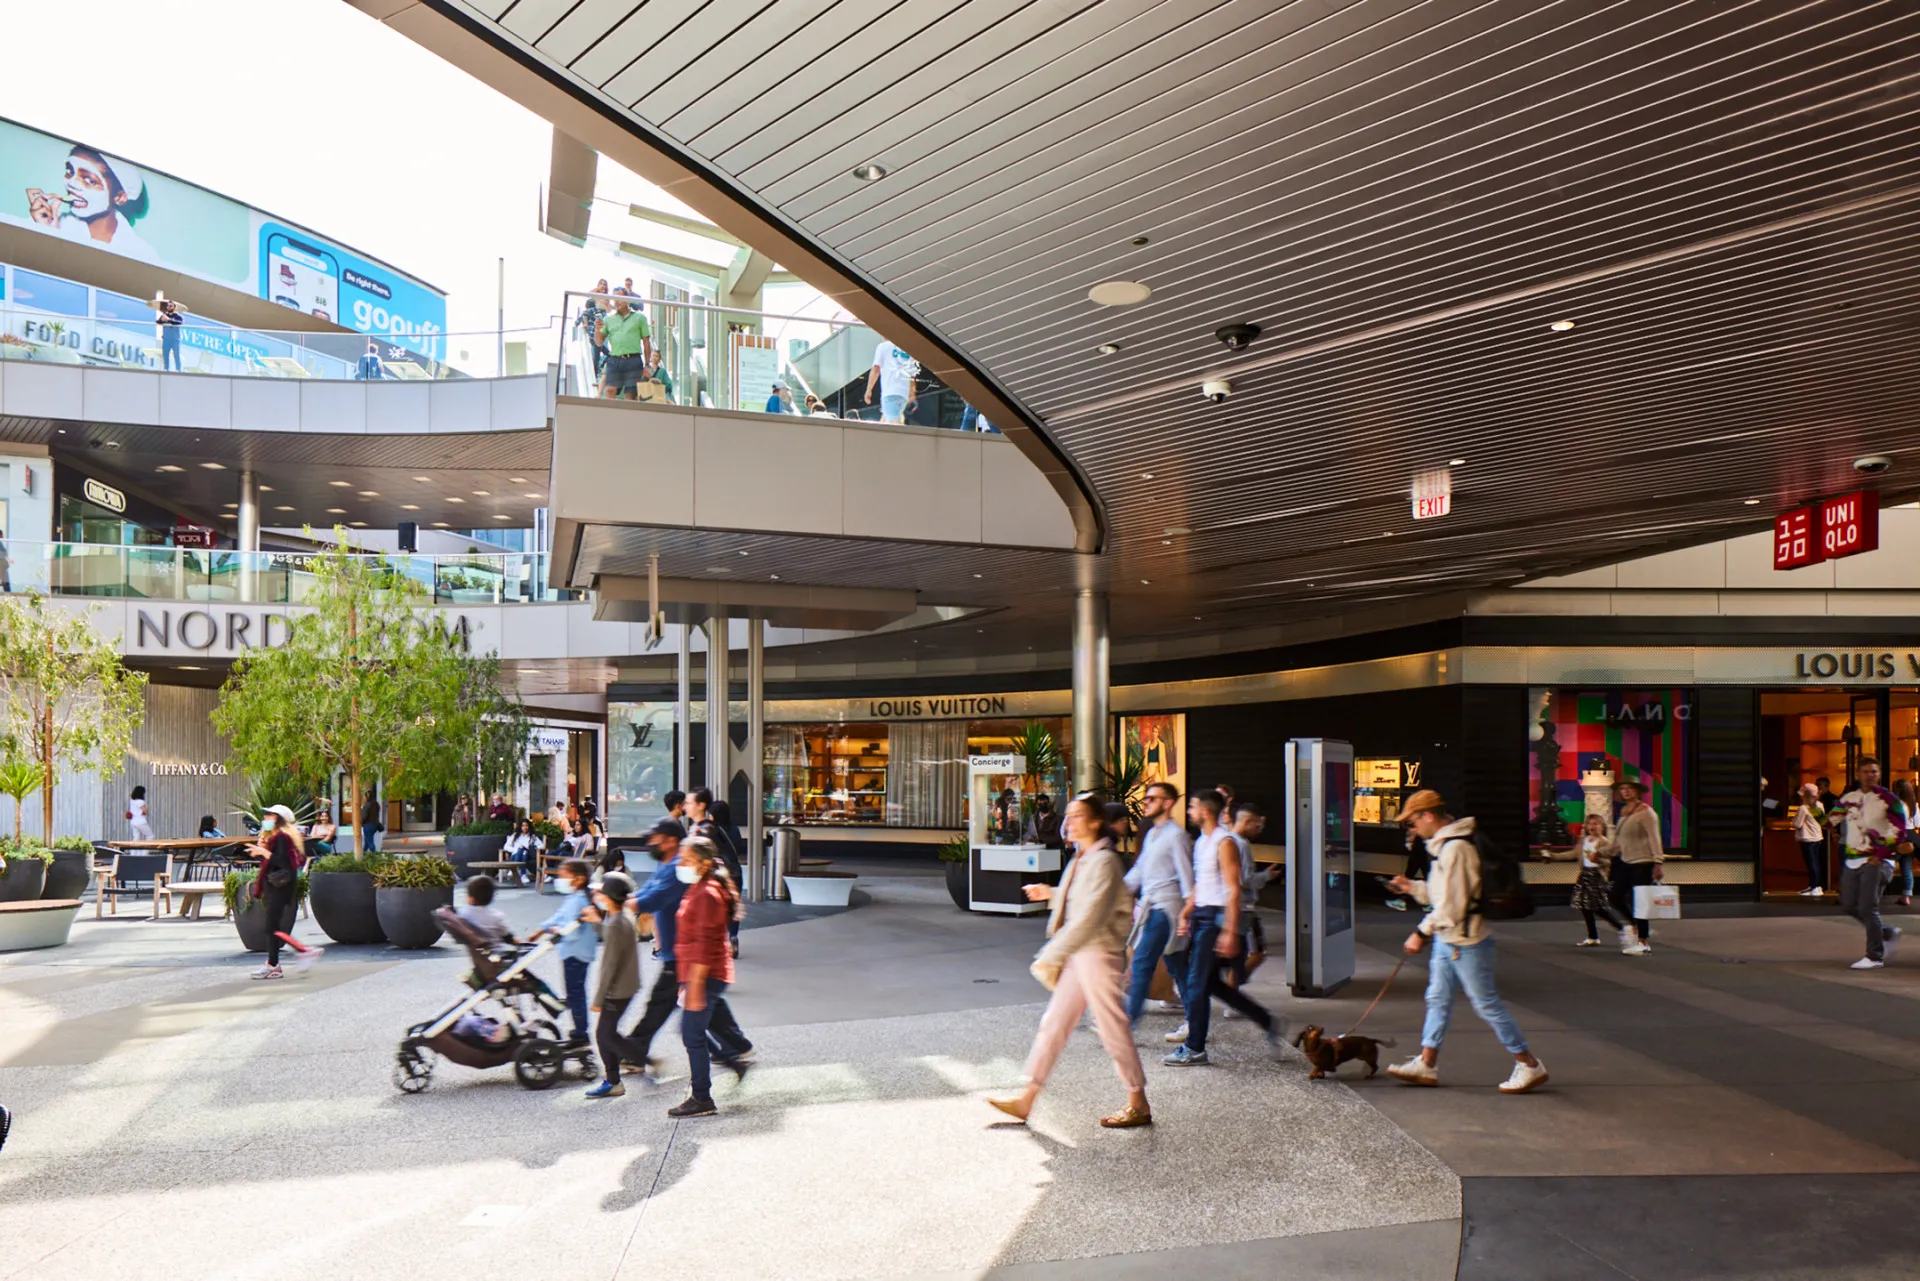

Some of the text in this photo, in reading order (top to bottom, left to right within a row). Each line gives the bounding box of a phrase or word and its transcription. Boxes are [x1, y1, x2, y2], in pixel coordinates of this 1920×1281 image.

[356, 277, 371, 288] right
[353, 300, 440, 358] gopuff
[1419, 496, 1445, 517] EXIT
[1825, 501, 1855, 526] UNI
[1825, 524, 1857, 552] QLO
[1796, 653, 1895, 678] LOUIS
[870, 697, 1005, 717] LOUIS VUITTON
[971, 757, 1011, 767] Concierge
